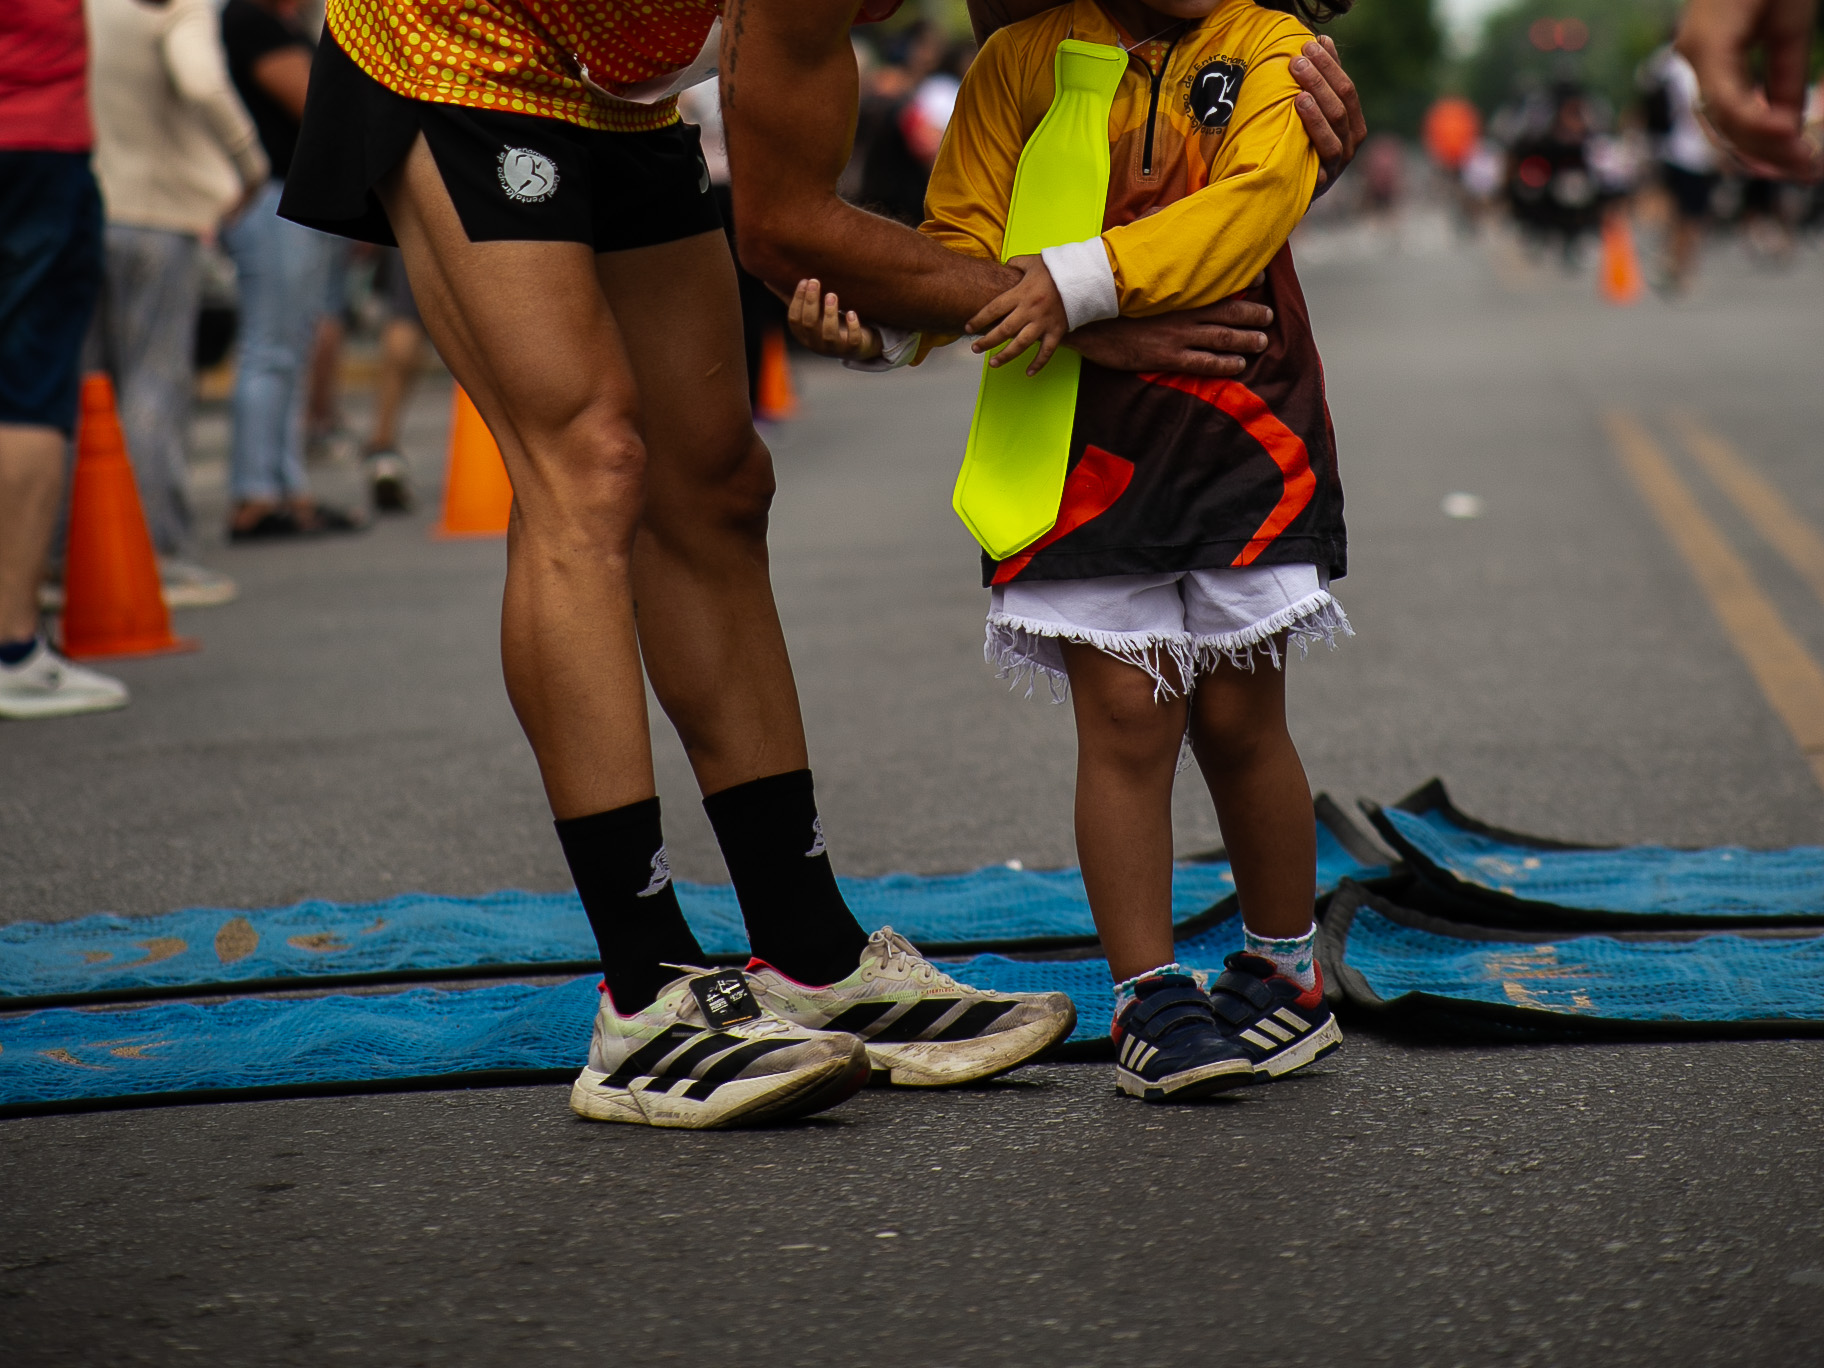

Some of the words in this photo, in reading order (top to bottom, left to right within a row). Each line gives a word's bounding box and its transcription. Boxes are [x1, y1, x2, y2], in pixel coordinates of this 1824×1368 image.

[1184, 75, 1194, 88] de
[1183, 93, 1199, 128] Grupo
[1201, 127, 1223, 136] enta
[497, 152, 506, 163] de
[497, 167, 514, 195] Grupo
[516, 195, 545, 203] Penta
